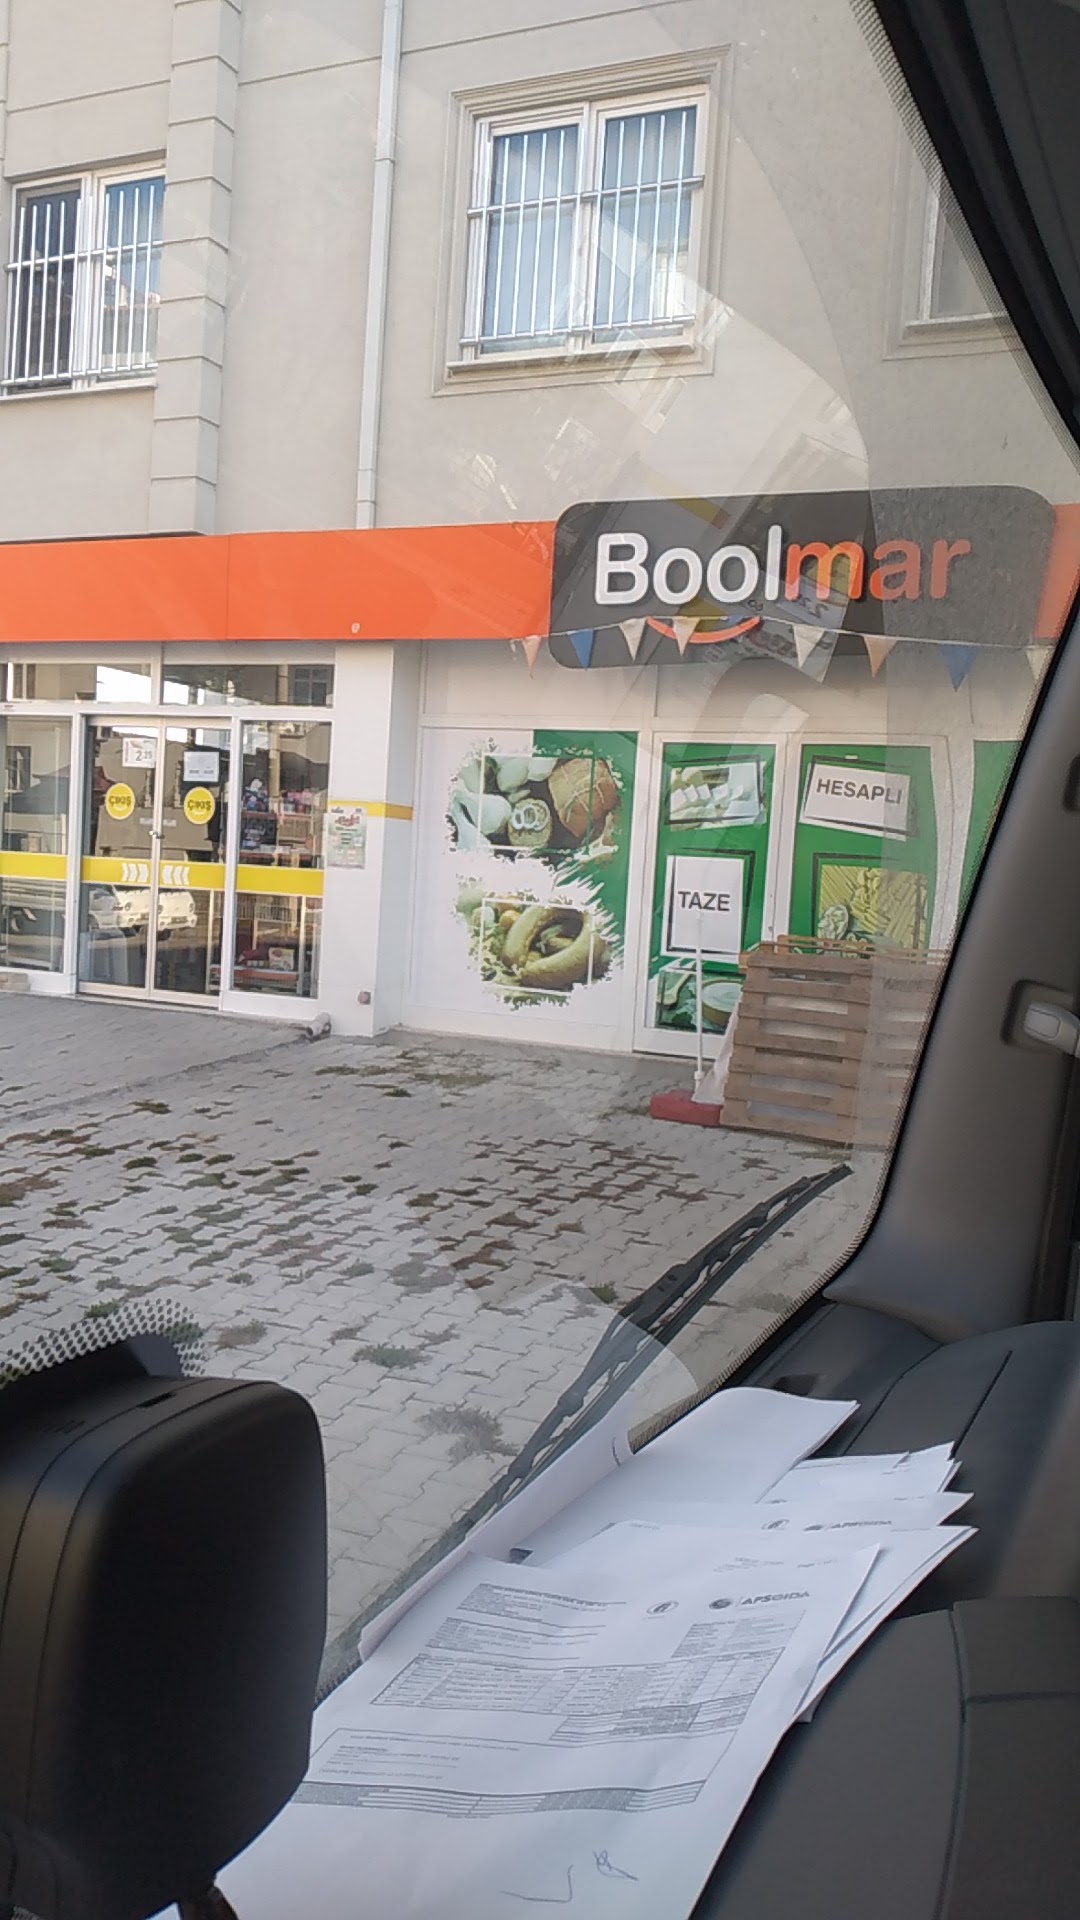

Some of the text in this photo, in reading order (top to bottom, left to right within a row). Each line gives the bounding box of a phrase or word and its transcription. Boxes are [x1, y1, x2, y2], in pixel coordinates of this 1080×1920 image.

[595, 524, 972, 605] Boolmar
[816, 778, 903, 805] HESAPLI
[677, 890, 730, 912] TAZE
